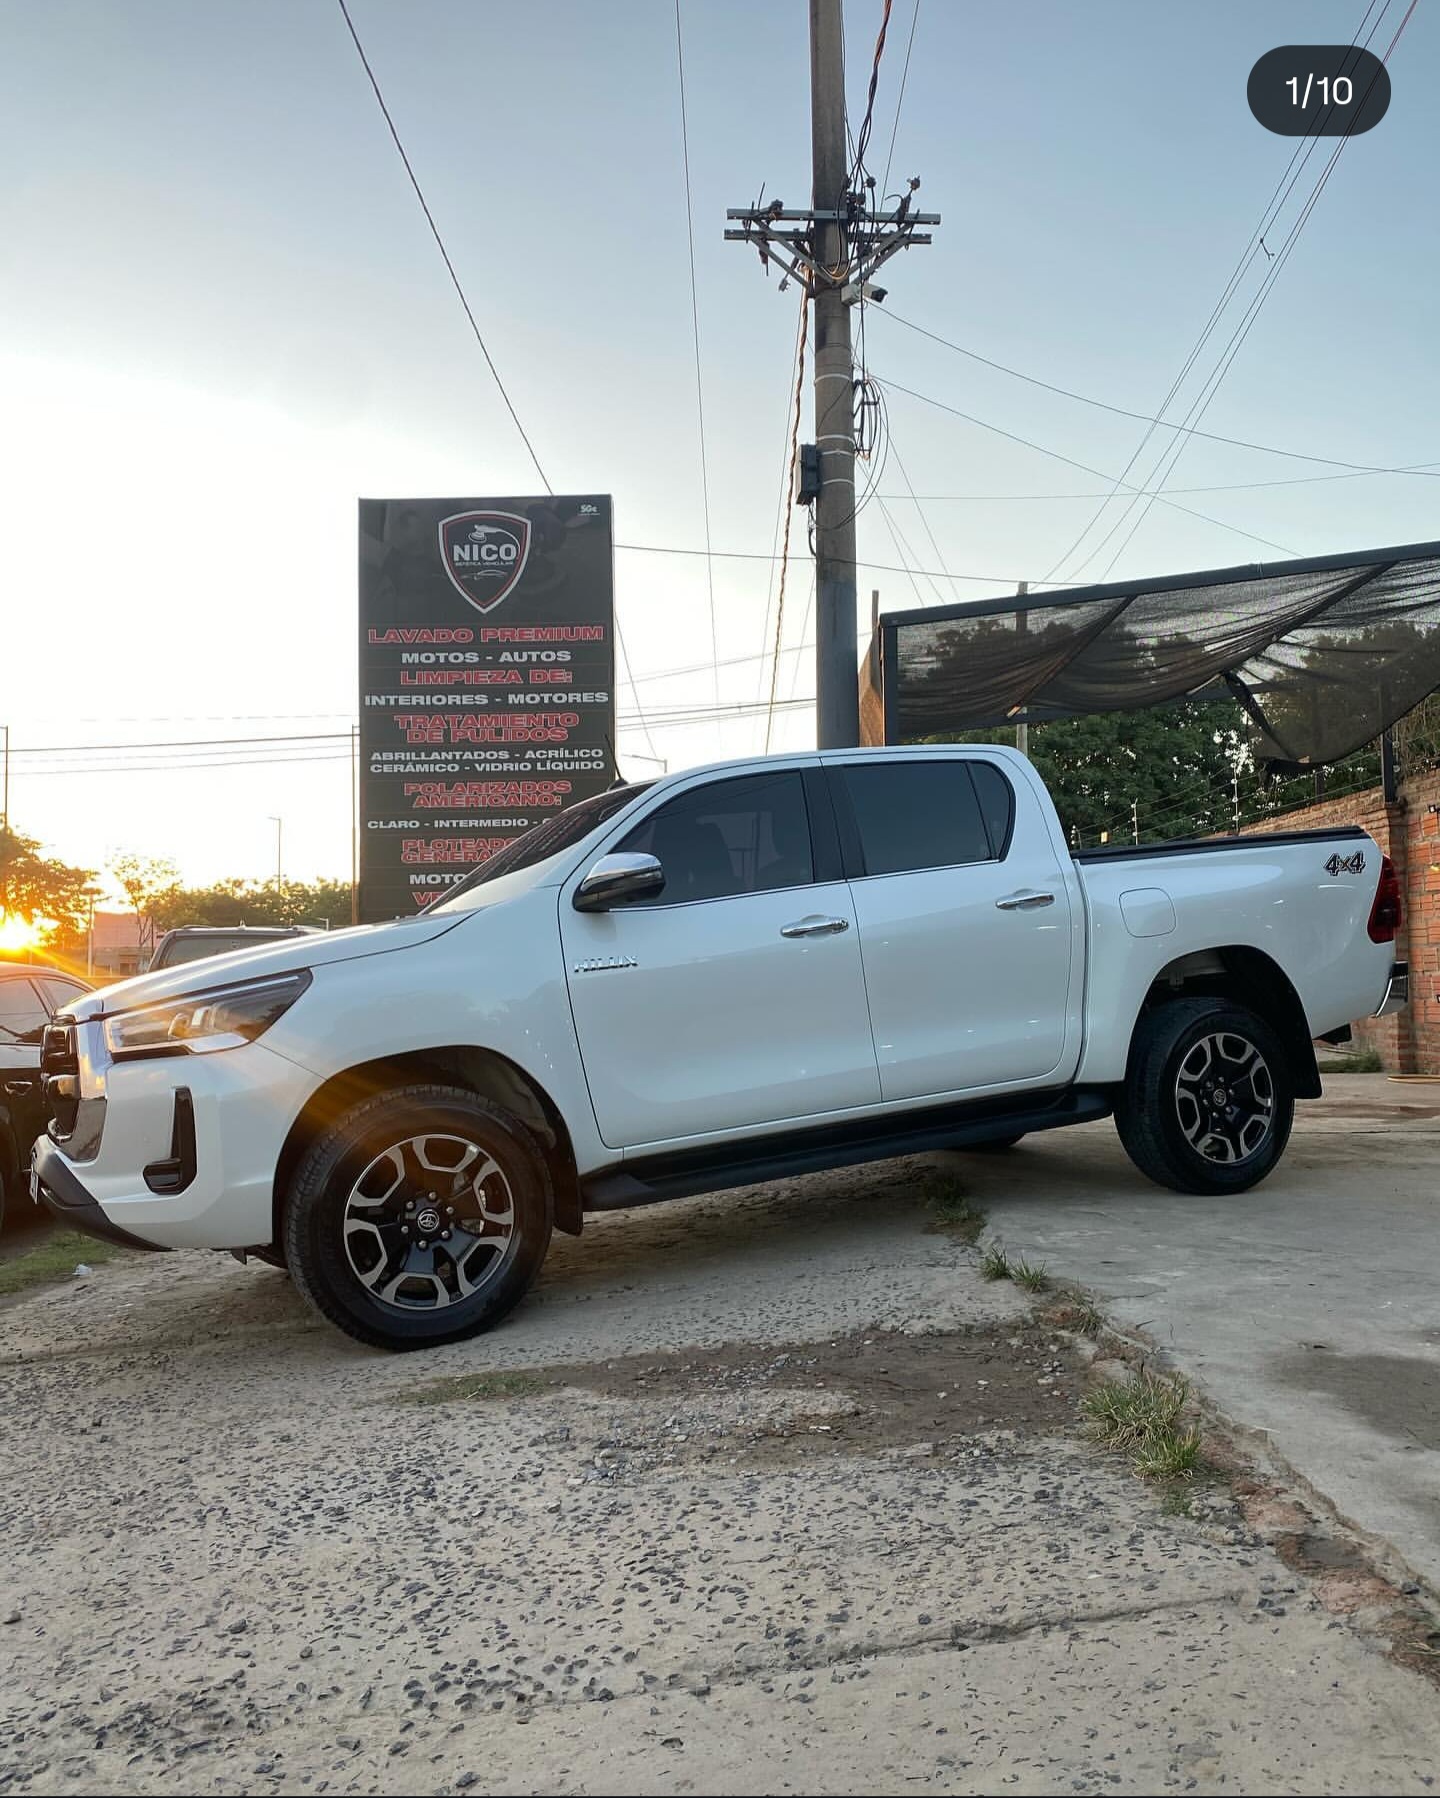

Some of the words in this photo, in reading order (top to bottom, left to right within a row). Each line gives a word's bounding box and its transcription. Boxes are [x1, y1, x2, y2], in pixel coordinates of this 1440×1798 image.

[453, 544, 517, 561] NICO
[368, 627, 474, 644] LAVADO
[481, 626, 603, 643] PREMIUM
[401, 651, 480, 664] MOTOS
[499, 650, 572, 663] AUTOS
[400, 669, 524, 685] LIMPIEZA
[529, 668, 573, 684] DE:
[365, 693, 489, 706] INTERIORES
[508, 692, 609, 705] MOTORES
[394, 712, 580, 730] TRATAMIENTO
[407, 728, 444, 743] DE
[451, 727, 569, 743] PULIDOS
[370, 750, 510, 761] ABRILLANTADOS
[525, 748, 604, 759] ACRÍLICO
[370, 761, 460, 773] CERÁMICO
[474, 762, 532, 772] VIDRIO
[537, 760, 605, 772] LÍQUIDO
[404, 780, 572, 796] POLARIZADOS
[413, 793, 562, 808] AMERICANO:
[367, 820, 420, 829] CLARO
[434, 818, 529, 829] INTERMEDIO
[400, 849, 500, 864] GENERA
[1323, 850, 1366, 877] 4x4
[409, 874, 467, 885] MOTO
